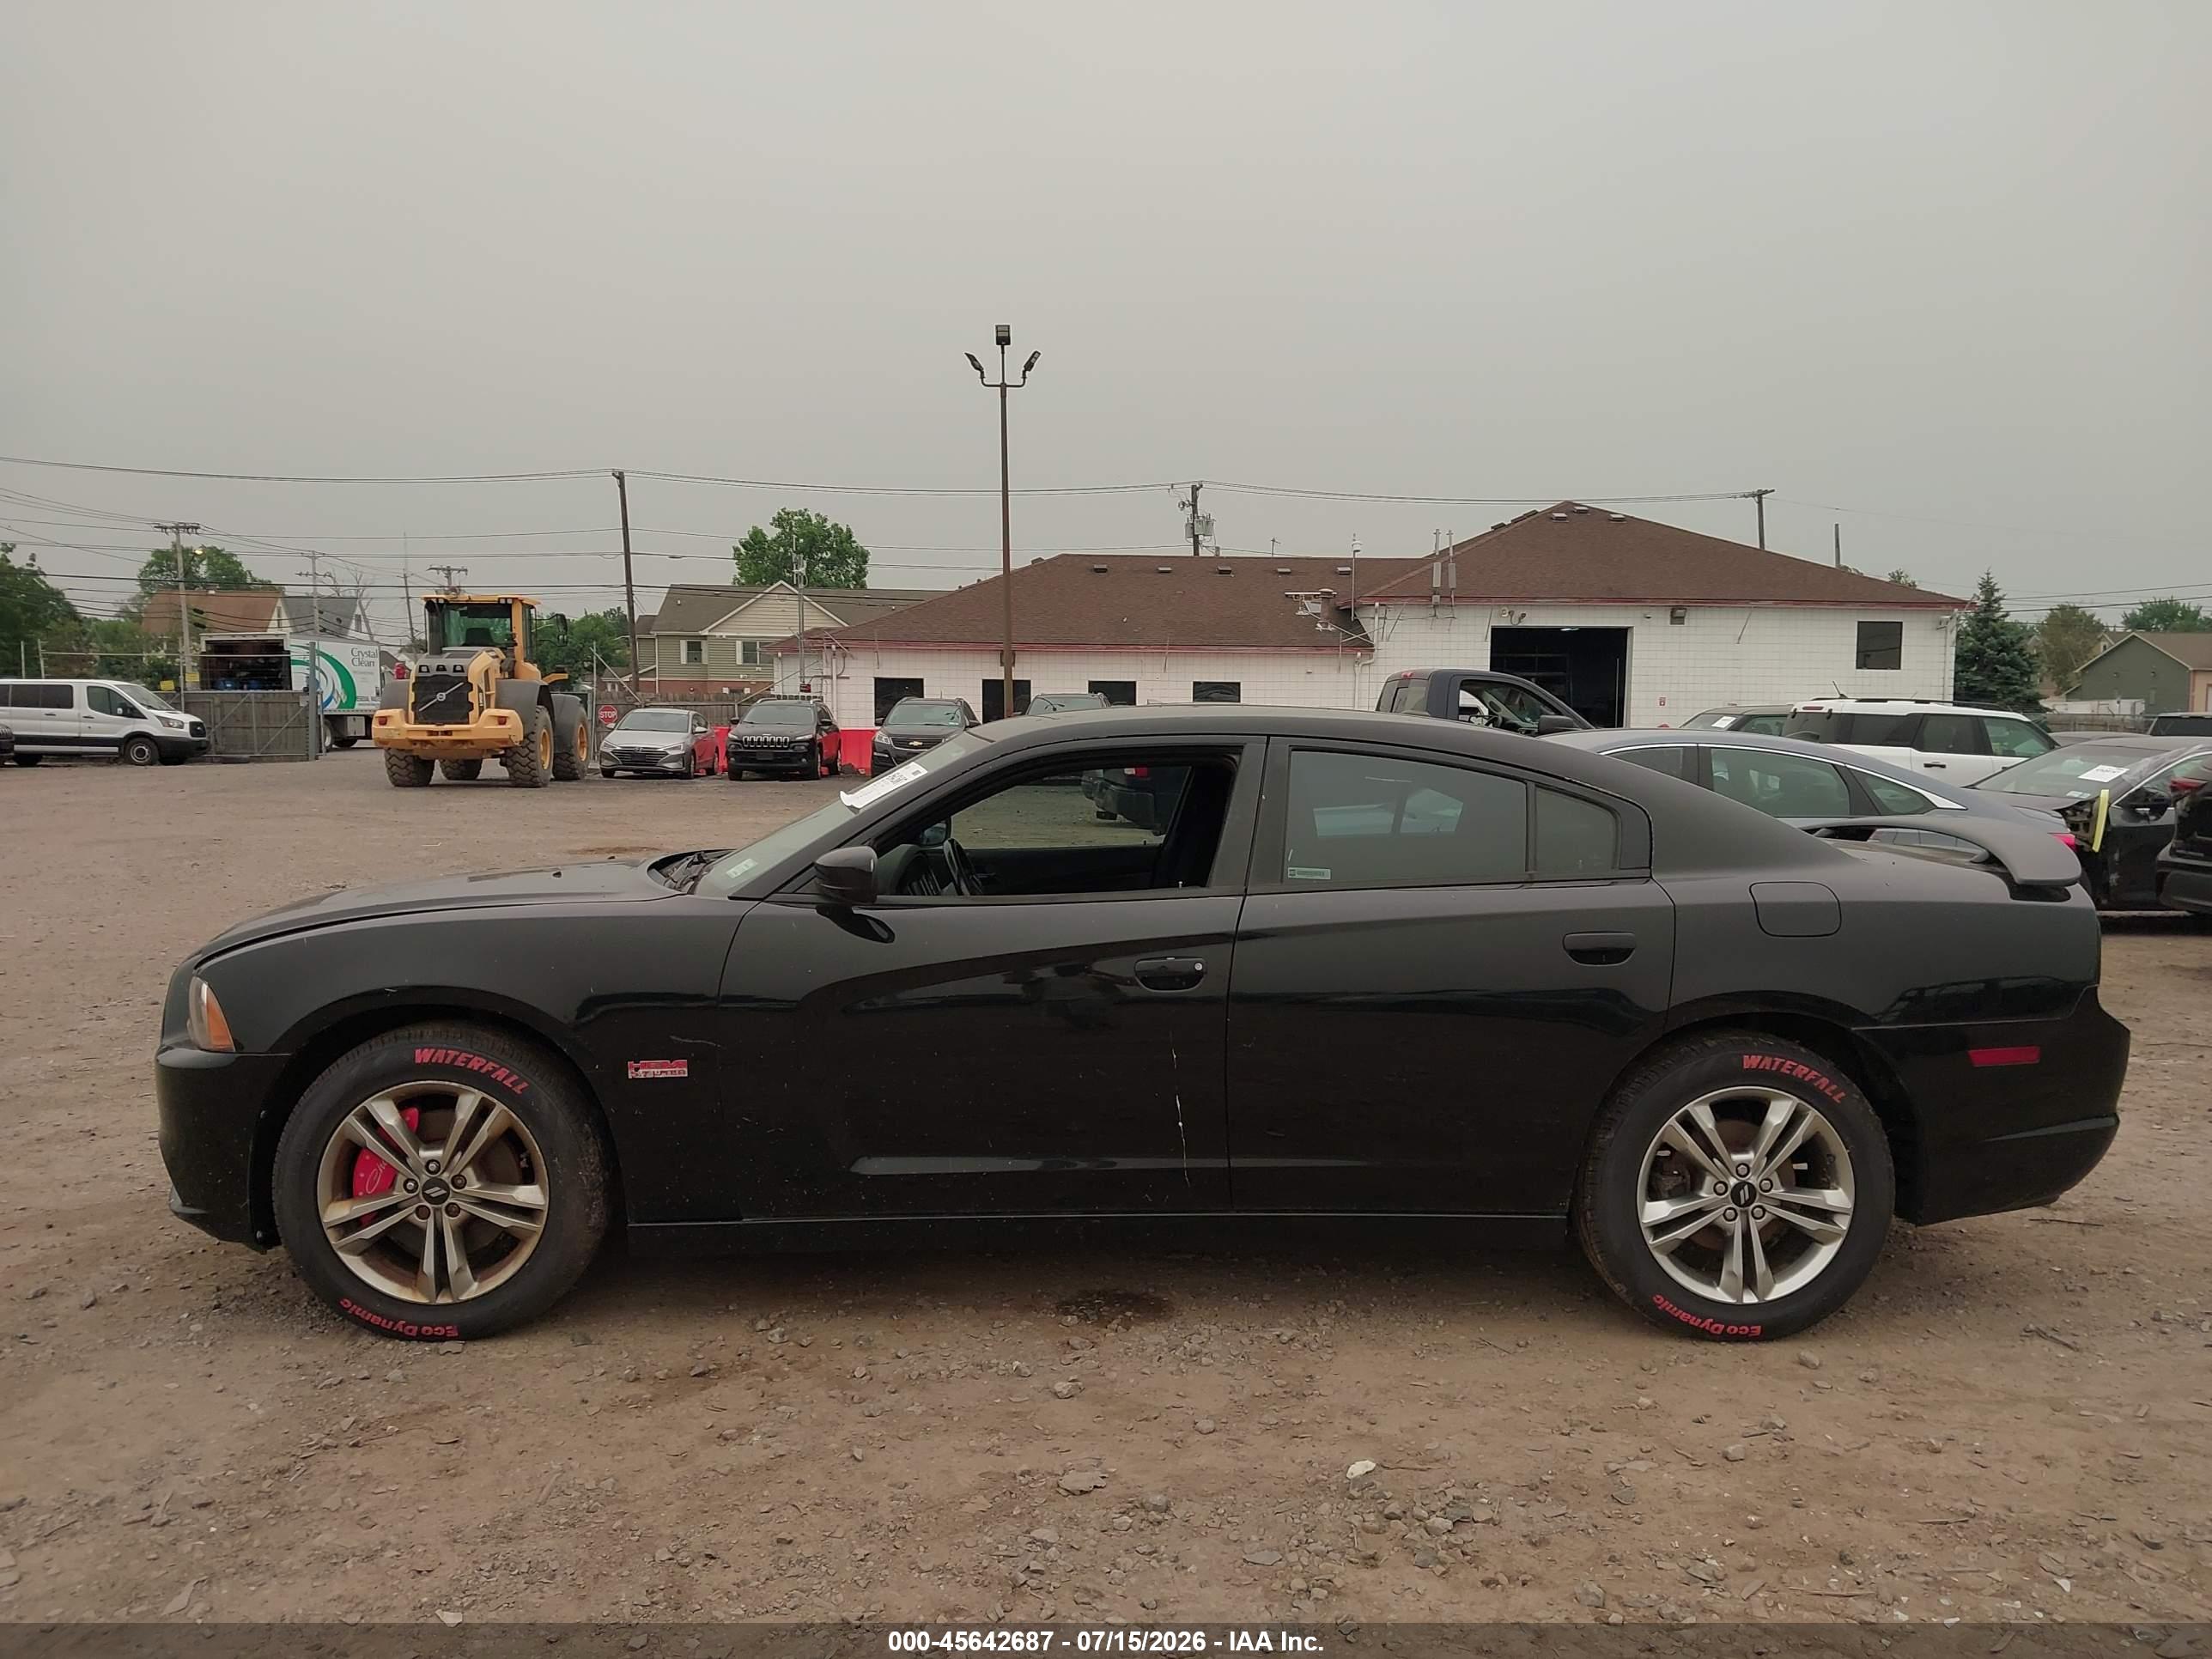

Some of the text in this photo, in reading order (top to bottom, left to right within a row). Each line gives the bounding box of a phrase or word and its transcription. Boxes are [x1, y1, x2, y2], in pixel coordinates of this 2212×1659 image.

[350, 647, 378, 660] Crystal
[351, 658, 375, 667] Clean
[415, 1048, 529, 1094] WATERFALL
[1742, 1054, 1846, 1103] WATERFALL
[339, 1297, 459, 1337] Eco Dynamic
[1652, 1294, 1762, 1336] Eco Dynamic
